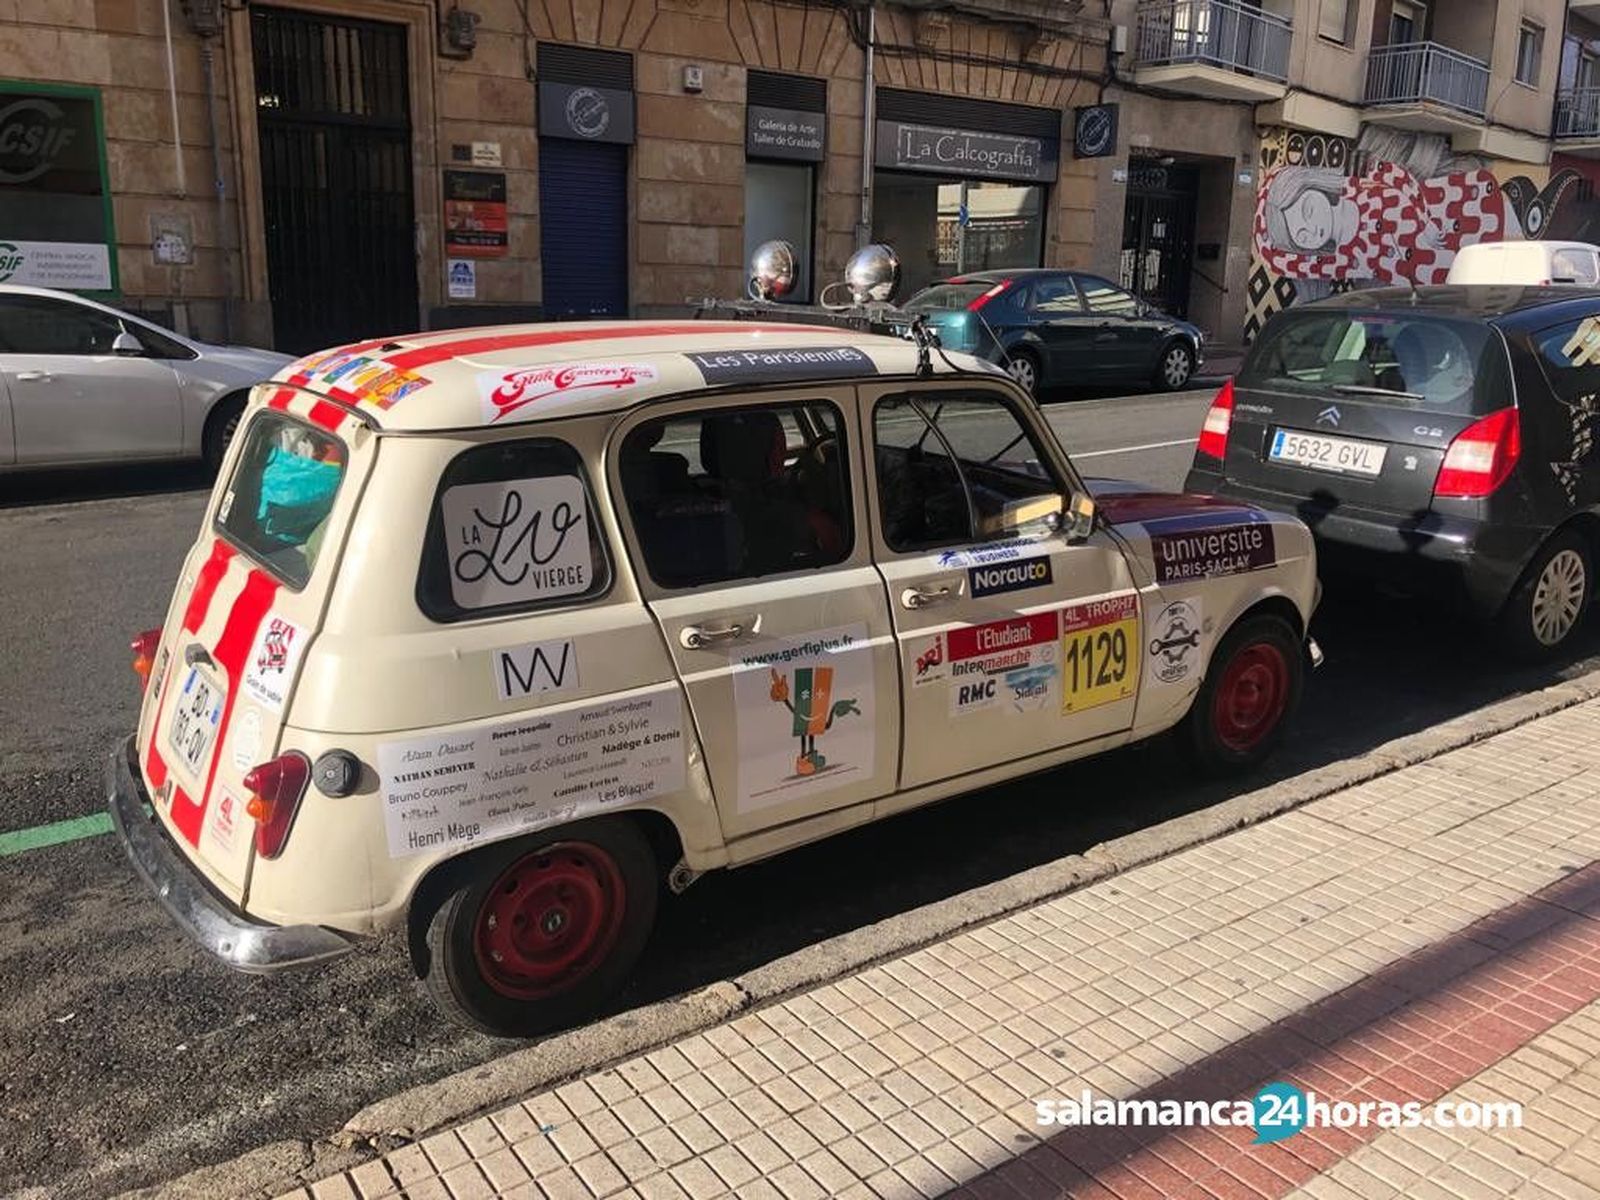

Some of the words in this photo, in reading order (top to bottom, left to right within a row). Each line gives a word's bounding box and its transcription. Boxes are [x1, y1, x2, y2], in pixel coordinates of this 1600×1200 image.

[906, 132, 931, 159] La
[698, 355, 741, 368] Les
[742, 348, 862, 366] Parisiennes
[1287, 437, 1332, 461] 5632
[1338, 445, 1373, 469] GVL
[462, 525, 481, 544] LA
[533, 565, 584, 590] VIERGE
[975, 562, 1047, 589] Norauto
[743, 635, 853, 666] www.gerfiplus.fr
[1067, 628, 1127, 693] 1129
[959, 679, 997, 705] RMC
[557, 728, 606, 747] Christian
[608, 724, 616, 736] &
[618, 718, 649, 734] Sylvie
[643, 735, 651, 745] &
[653, 729, 681, 741] Denis
[388, 793, 421, 805] Bruno
[408, 826, 445, 850] Henri
